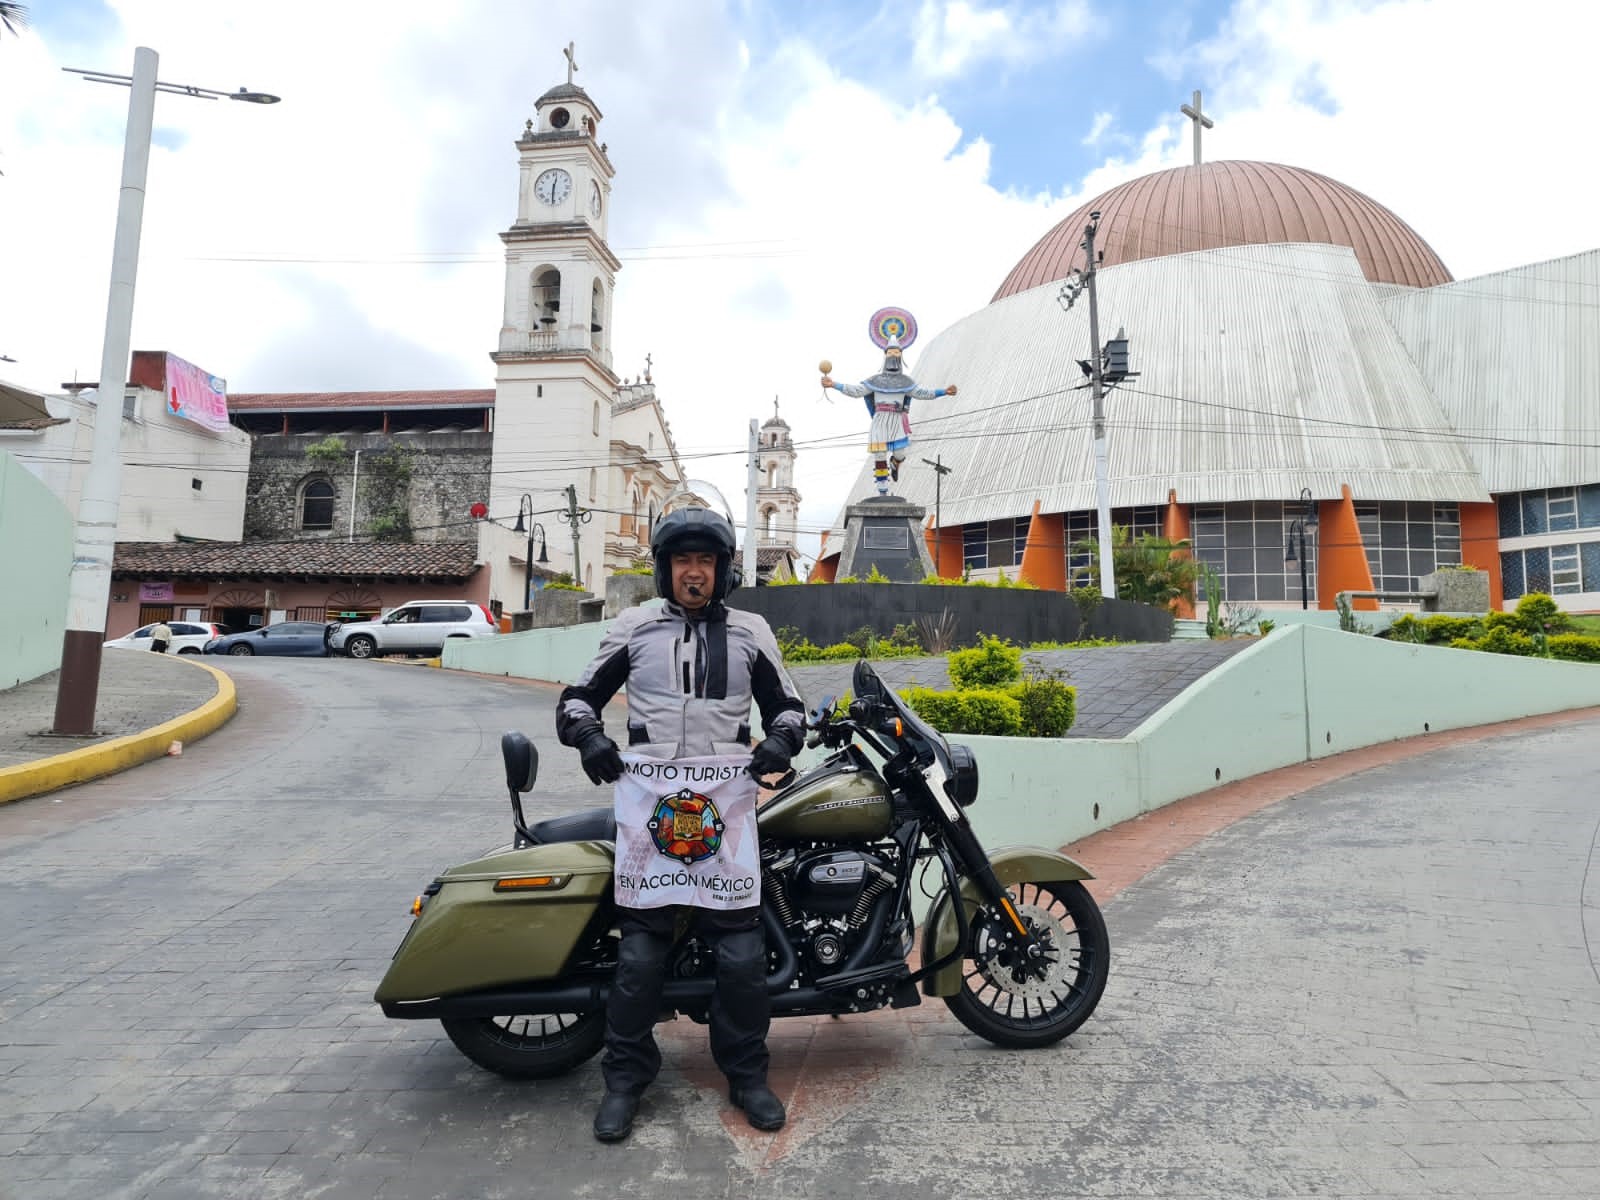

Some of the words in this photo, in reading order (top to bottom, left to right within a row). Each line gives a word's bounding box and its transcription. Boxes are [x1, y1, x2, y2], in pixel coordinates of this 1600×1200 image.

[624, 762, 678, 780] MOTO
[619, 875, 635, 890] EN
[639, 869, 698, 890] ACCIÓN
[702, 874, 754, 892] MÉXICO
